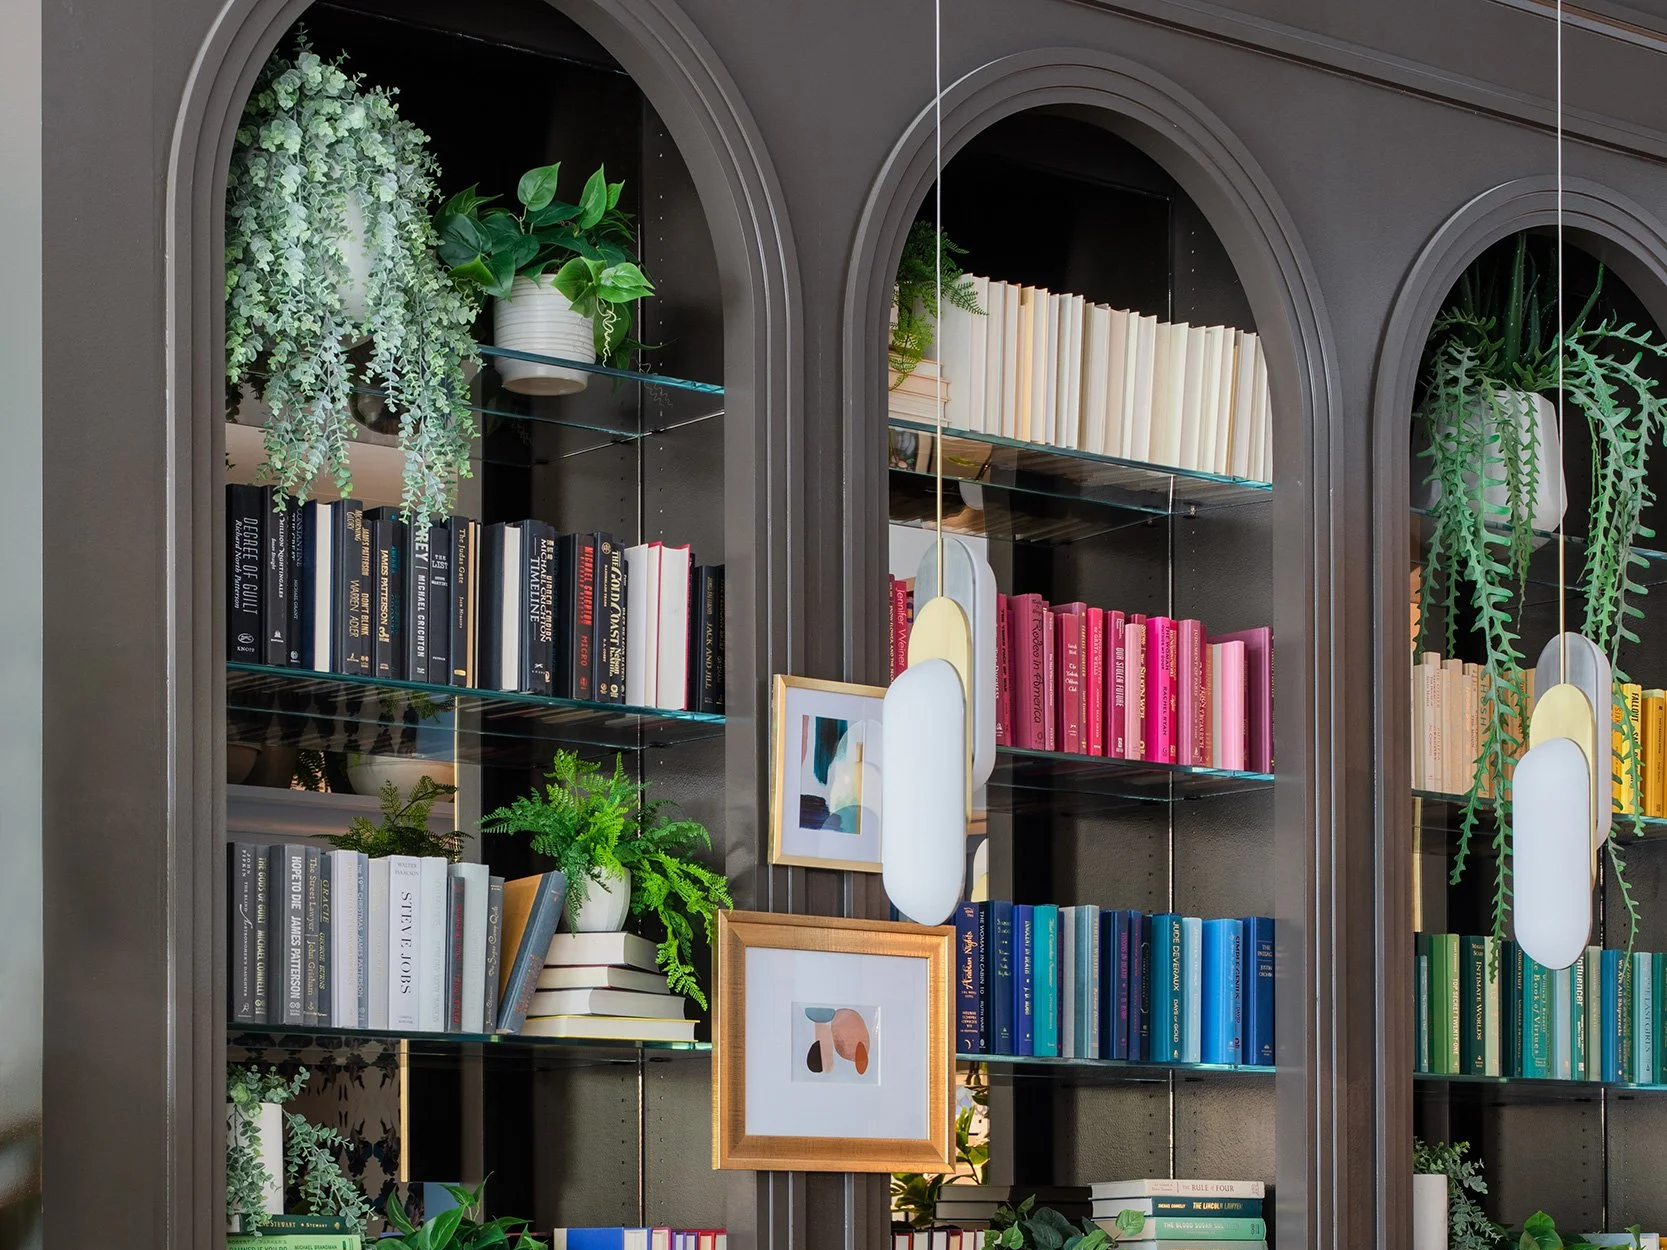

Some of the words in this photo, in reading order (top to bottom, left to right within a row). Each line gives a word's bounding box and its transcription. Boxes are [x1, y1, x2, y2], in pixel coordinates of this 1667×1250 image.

[347, 511, 355, 530] GLORY
[354, 509, 363, 541] MOURNING
[234, 520, 243, 548] Richard
[242, 517, 258, 560] DEGREE
[361, 527, 369, 545] JAMES
[458, 529, 466, 543] The
[234, 550, 243, 573] North
[361, 546, 369, 576] PATTERSON
[380, 550, 388, 576] JAMES
[458, 544, 466, 565] Judas
[584, 546, 593, 581] MICHAEL
[611, 551, 619, 567] THE
[242, 565, 258, 580] OF
[458, 567, 466, 583] Gate
[610, 566, 622, 601] GOLD
[234, 575, 243, 608] Patterson
[242, 584, 258, 614] GUILT
[349, 580, 359, 611] WARREN
[380, 577, 388, 625] PATTERSON
[417, 575, 425, 611] MICHAEL
[529, 556, 540, 622] TIMELINE
[361, 593, 369, 612] DON'T
[584, 585, 593, 625] CRICHTON
[896, 588, 906, 625] Jennifer
[349, 615, 359, 637] ADLER
[361, 615, 369, 635] BLINK
[610, 601, 622, 645] COAST
[705, 621, 713, 645] JACK
[417, 614, 425, 657] CRICHTON
[1032, 619, 1042, 657] Rodeo
[580, 635, 588, 666] MICRO
[705, 647, 713, 669] AND
[896, 629, 906, 667] Weiner
[1115, 647, 1124, 660] OUR
[614, 647, 622, 674] Nelson
[1032, 660, 1042, 669] in
[1115, 661, 1124, 684] STOLEN
[705, 670, 713, 689] JILL
[1032, 672, 1042, 723] America
[1115, 685, 1124, 707] FUTURE
[258, 857, 266, 870] THE
[291, 856, 301, 880] HOPE
[309, 858, 317, 873] The
[258, 872, 266, 892] GODS
[291, 881, 301, 892] TO
[309, 875, 317, 900] Street
[258, 893, 266, 902] OF
[291, 894, 301, 910] DIE
[258, 904, 266, 924] GUILT
[307, 902, 316, 931] Lawyer
[400, 892, 412, 947] STEVE
[290, 916, 301, 946] JAMES
[961, 931, 978, 954] Nights
[257, 930, 265, 960] MICHAEL
[307, 940, 316, 959] John
[487, 946, 497, 965] Sugar
[257, 962, 265, 996] CONNELLY
[290, 948, 301, 999] PATTERSON
[307, 962, 316, 996] Grisham
[400, 953, 412, 994] JOBS
[961, 957, 973, 991] Arabian
[1533, 1004, 1540, 1013] of
[1191, 1184, 1208, 1192] RULE
[1216, 1184, 1234, 1192] FOUR
[1192, 1202, 1202, 1210] THE
[1204, 1202, 1222, 1210] LINCOLN
